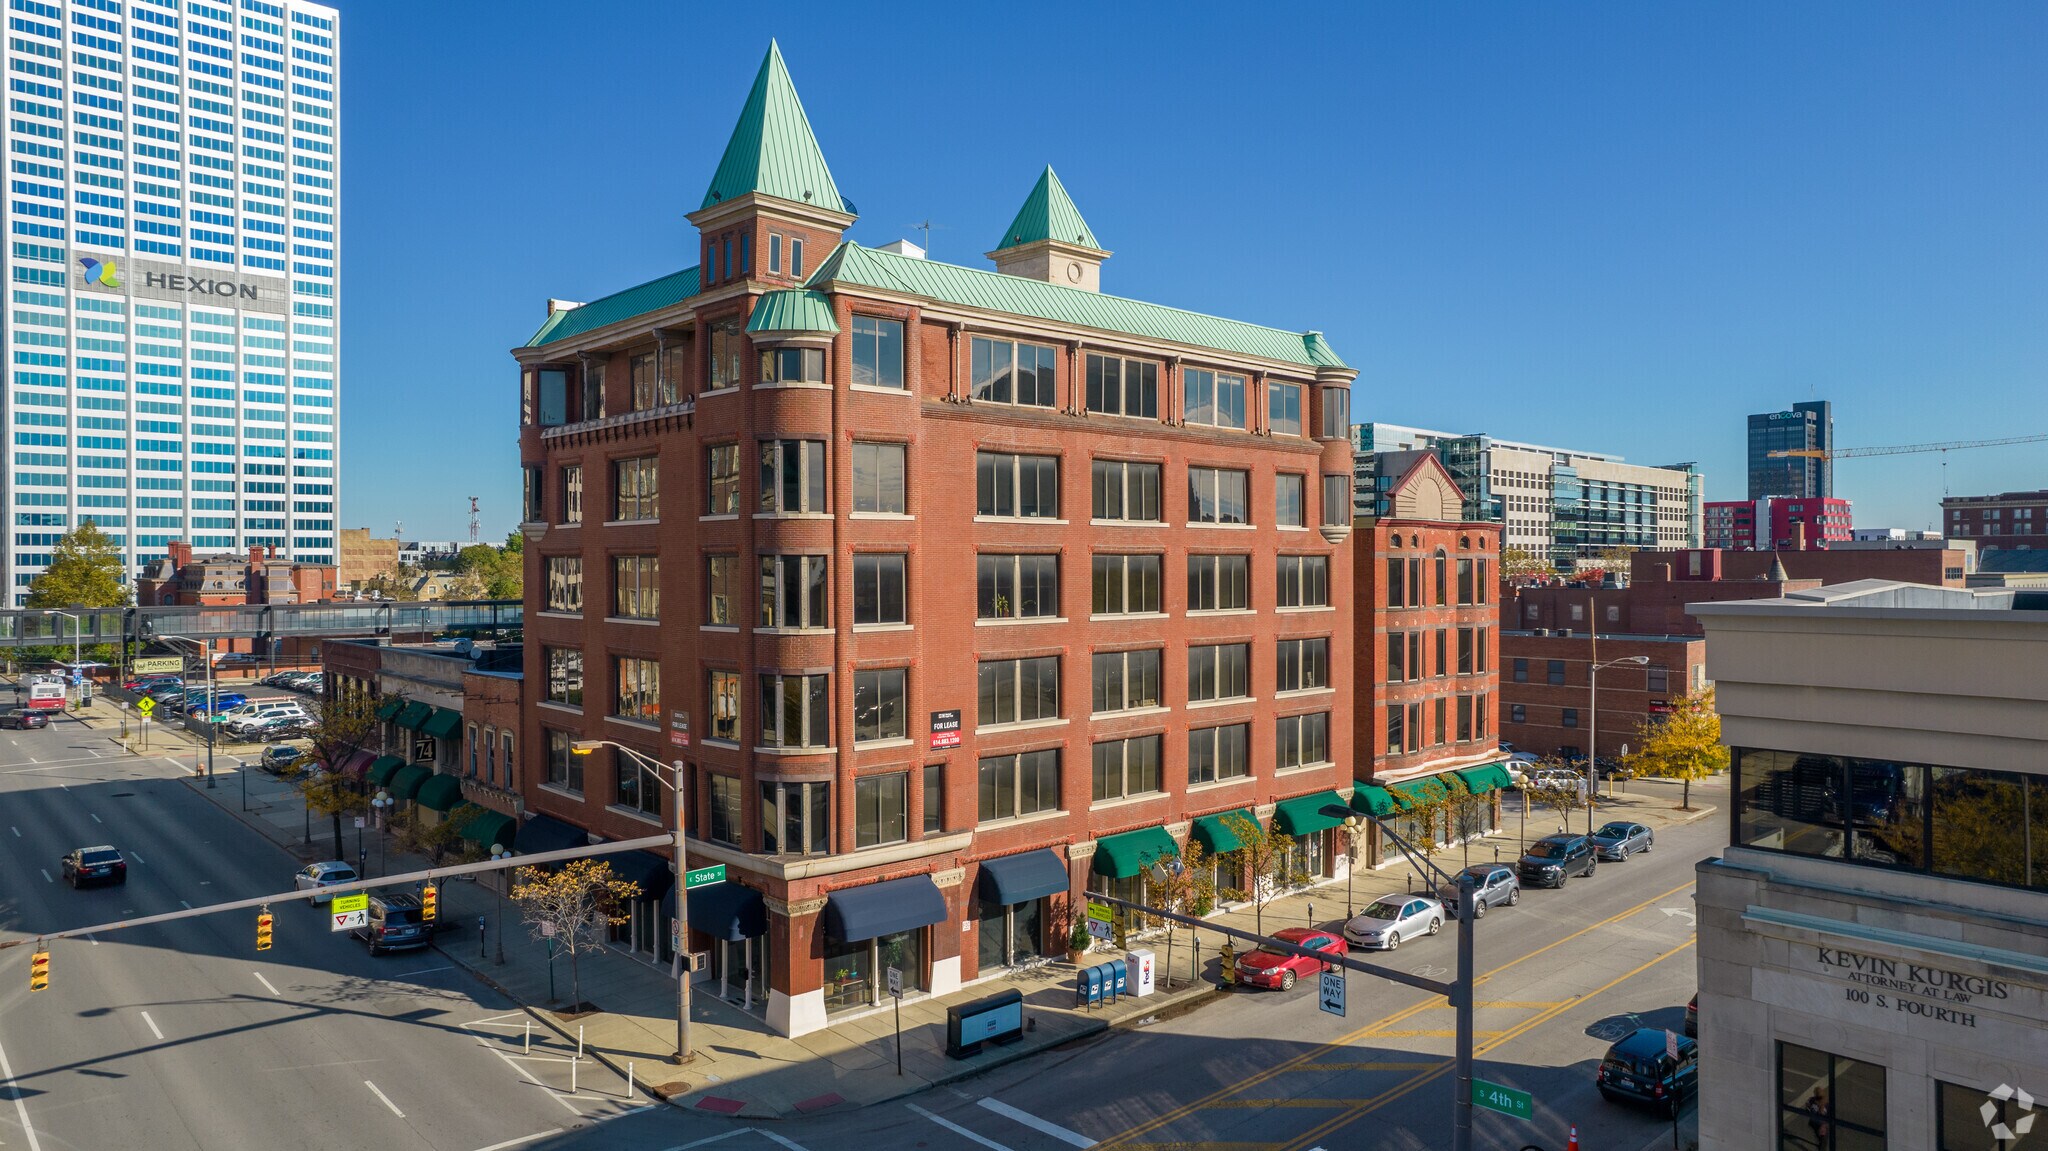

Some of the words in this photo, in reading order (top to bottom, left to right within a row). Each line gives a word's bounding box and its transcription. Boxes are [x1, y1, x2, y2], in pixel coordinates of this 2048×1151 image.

[146, 271, 258, 300] HEXION
[1769, 411, 1802, 420] encova
[147, 659, 180, 667] PARKING
[933, 722, 943, 730] FOR
[943, 720, 958, 729] LEASE
[416, 742, 433, 759] 74
[695, 872, 715, 883] State
[339, 902, 361, 910] VEHICLES
[340, 897, 361, 905] TURNING
[1143, 959, 1151, 985] FedEx
[1817, 946, 1897, 978] KEVIN
[1907, 964, 2008, 1000] KURGIS
[1323, 976, 1341, 990] ONE
[1847, 971, 1917, 993] ATTORNEY
[1922, 986, 1939, 998] AT
[1944, 990, 1973, 1004] LAW
[1323, 986, 1341, 999] WAY
[1845, 988, 1870, 1004] 100
[1876, 995, 1889, 1009] S.
[1896, 999, 1977, 1028] FOURTH
[1479, 1089, 1485, 1098] S
[1488, 1091, 1512, 1108] 4th
